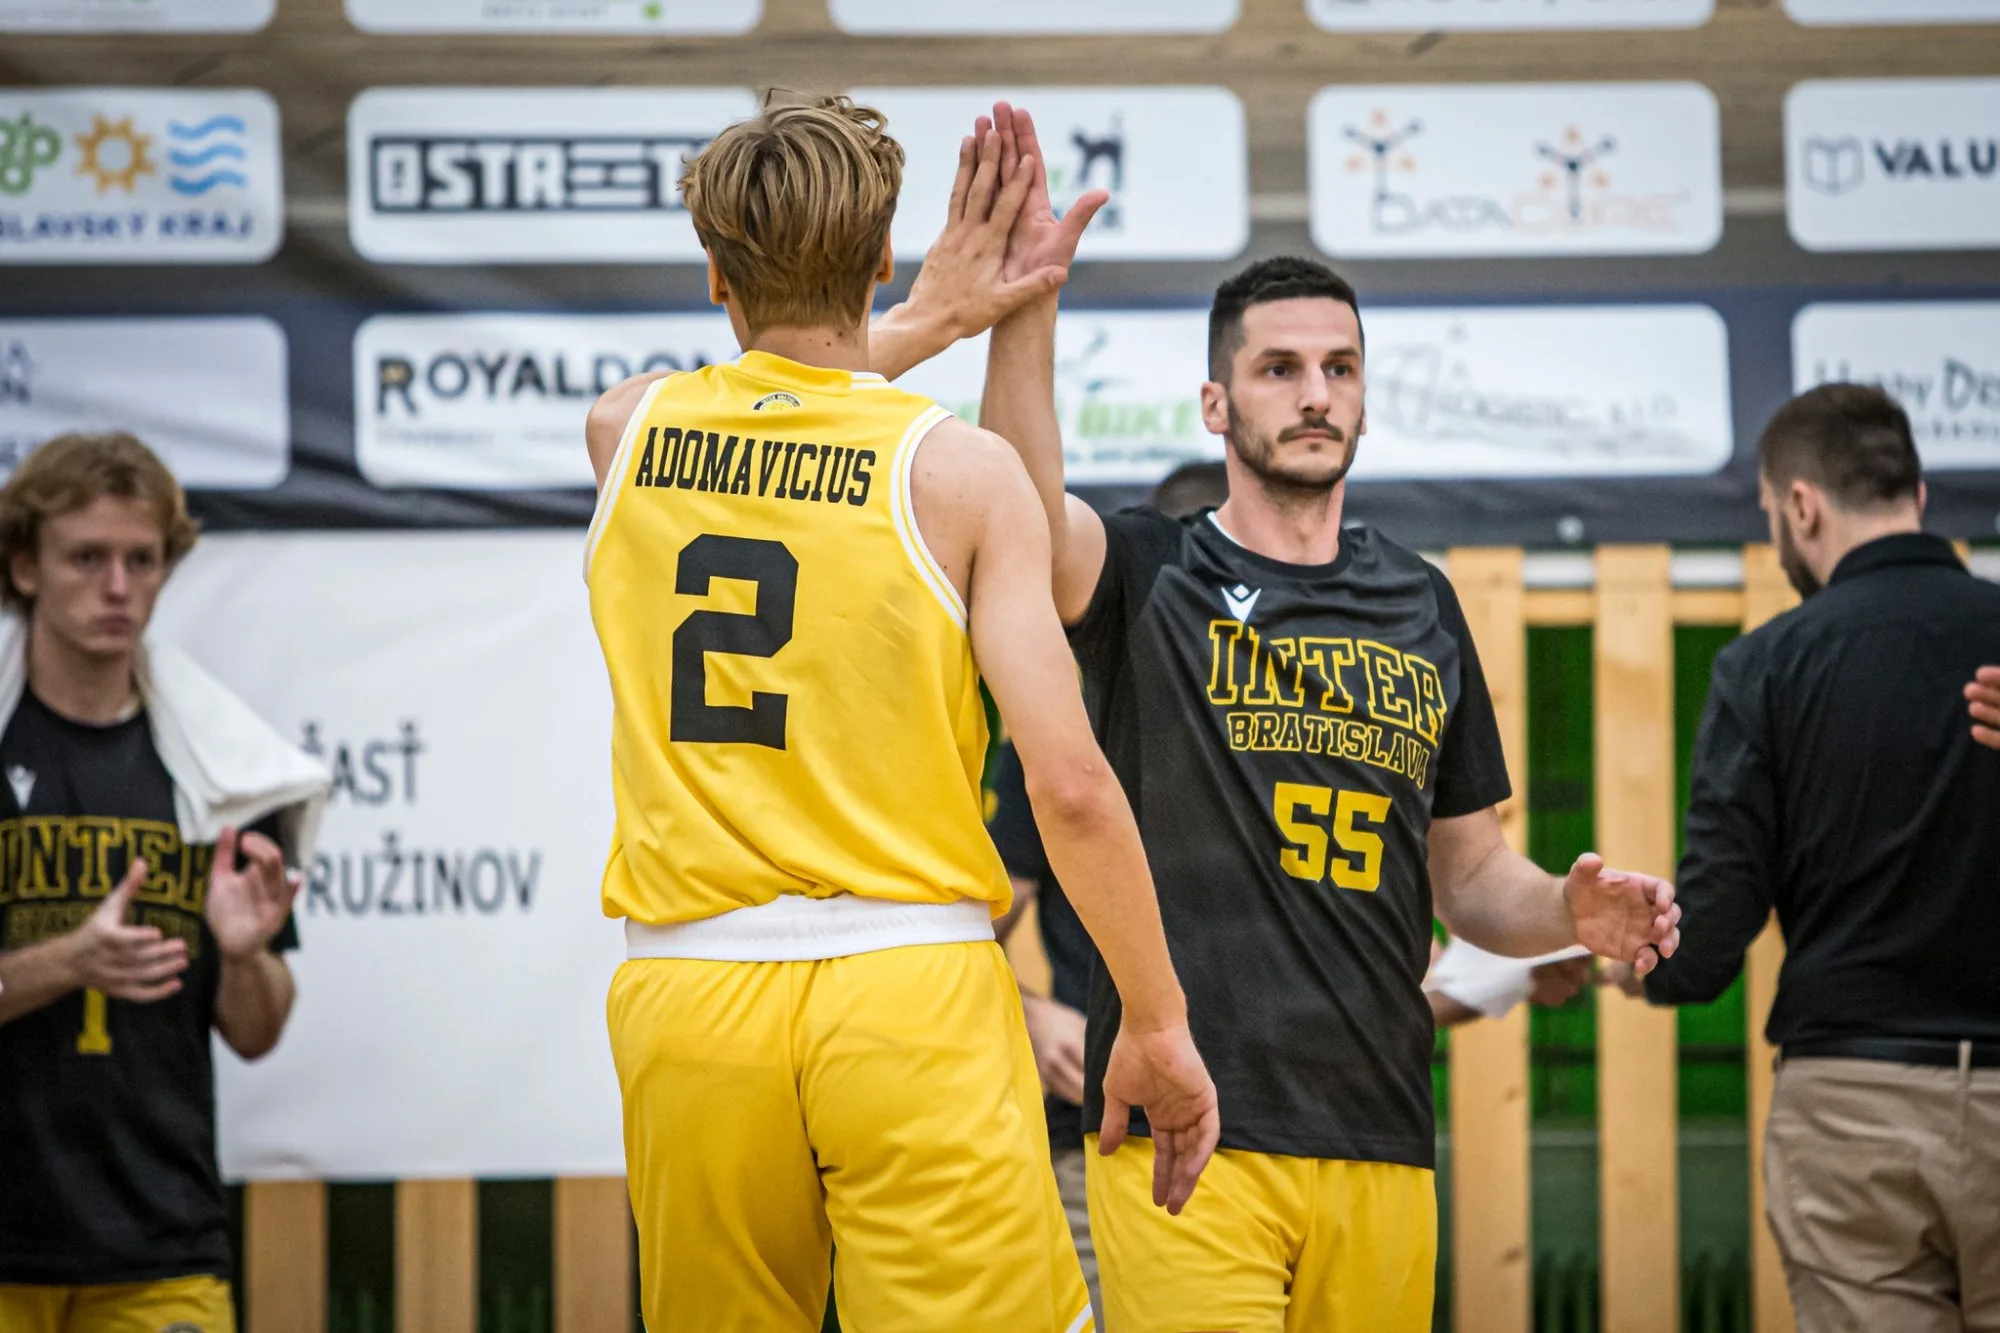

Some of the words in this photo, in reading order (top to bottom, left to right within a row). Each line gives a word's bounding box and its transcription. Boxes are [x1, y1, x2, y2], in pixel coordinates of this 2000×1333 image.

[1871, 137, 1997, 177] VALU
[635, 427, 876, 507] ADOMAVICIUS
[670, 533, 799, 751] 2
[1206, 619, 1447, 748] INTER
[1227, 712, 1430, 790] BRATISLAVA
[305, 831, 542, 915] RUŽINOV
[1273, 781, 1392, 893] 55
